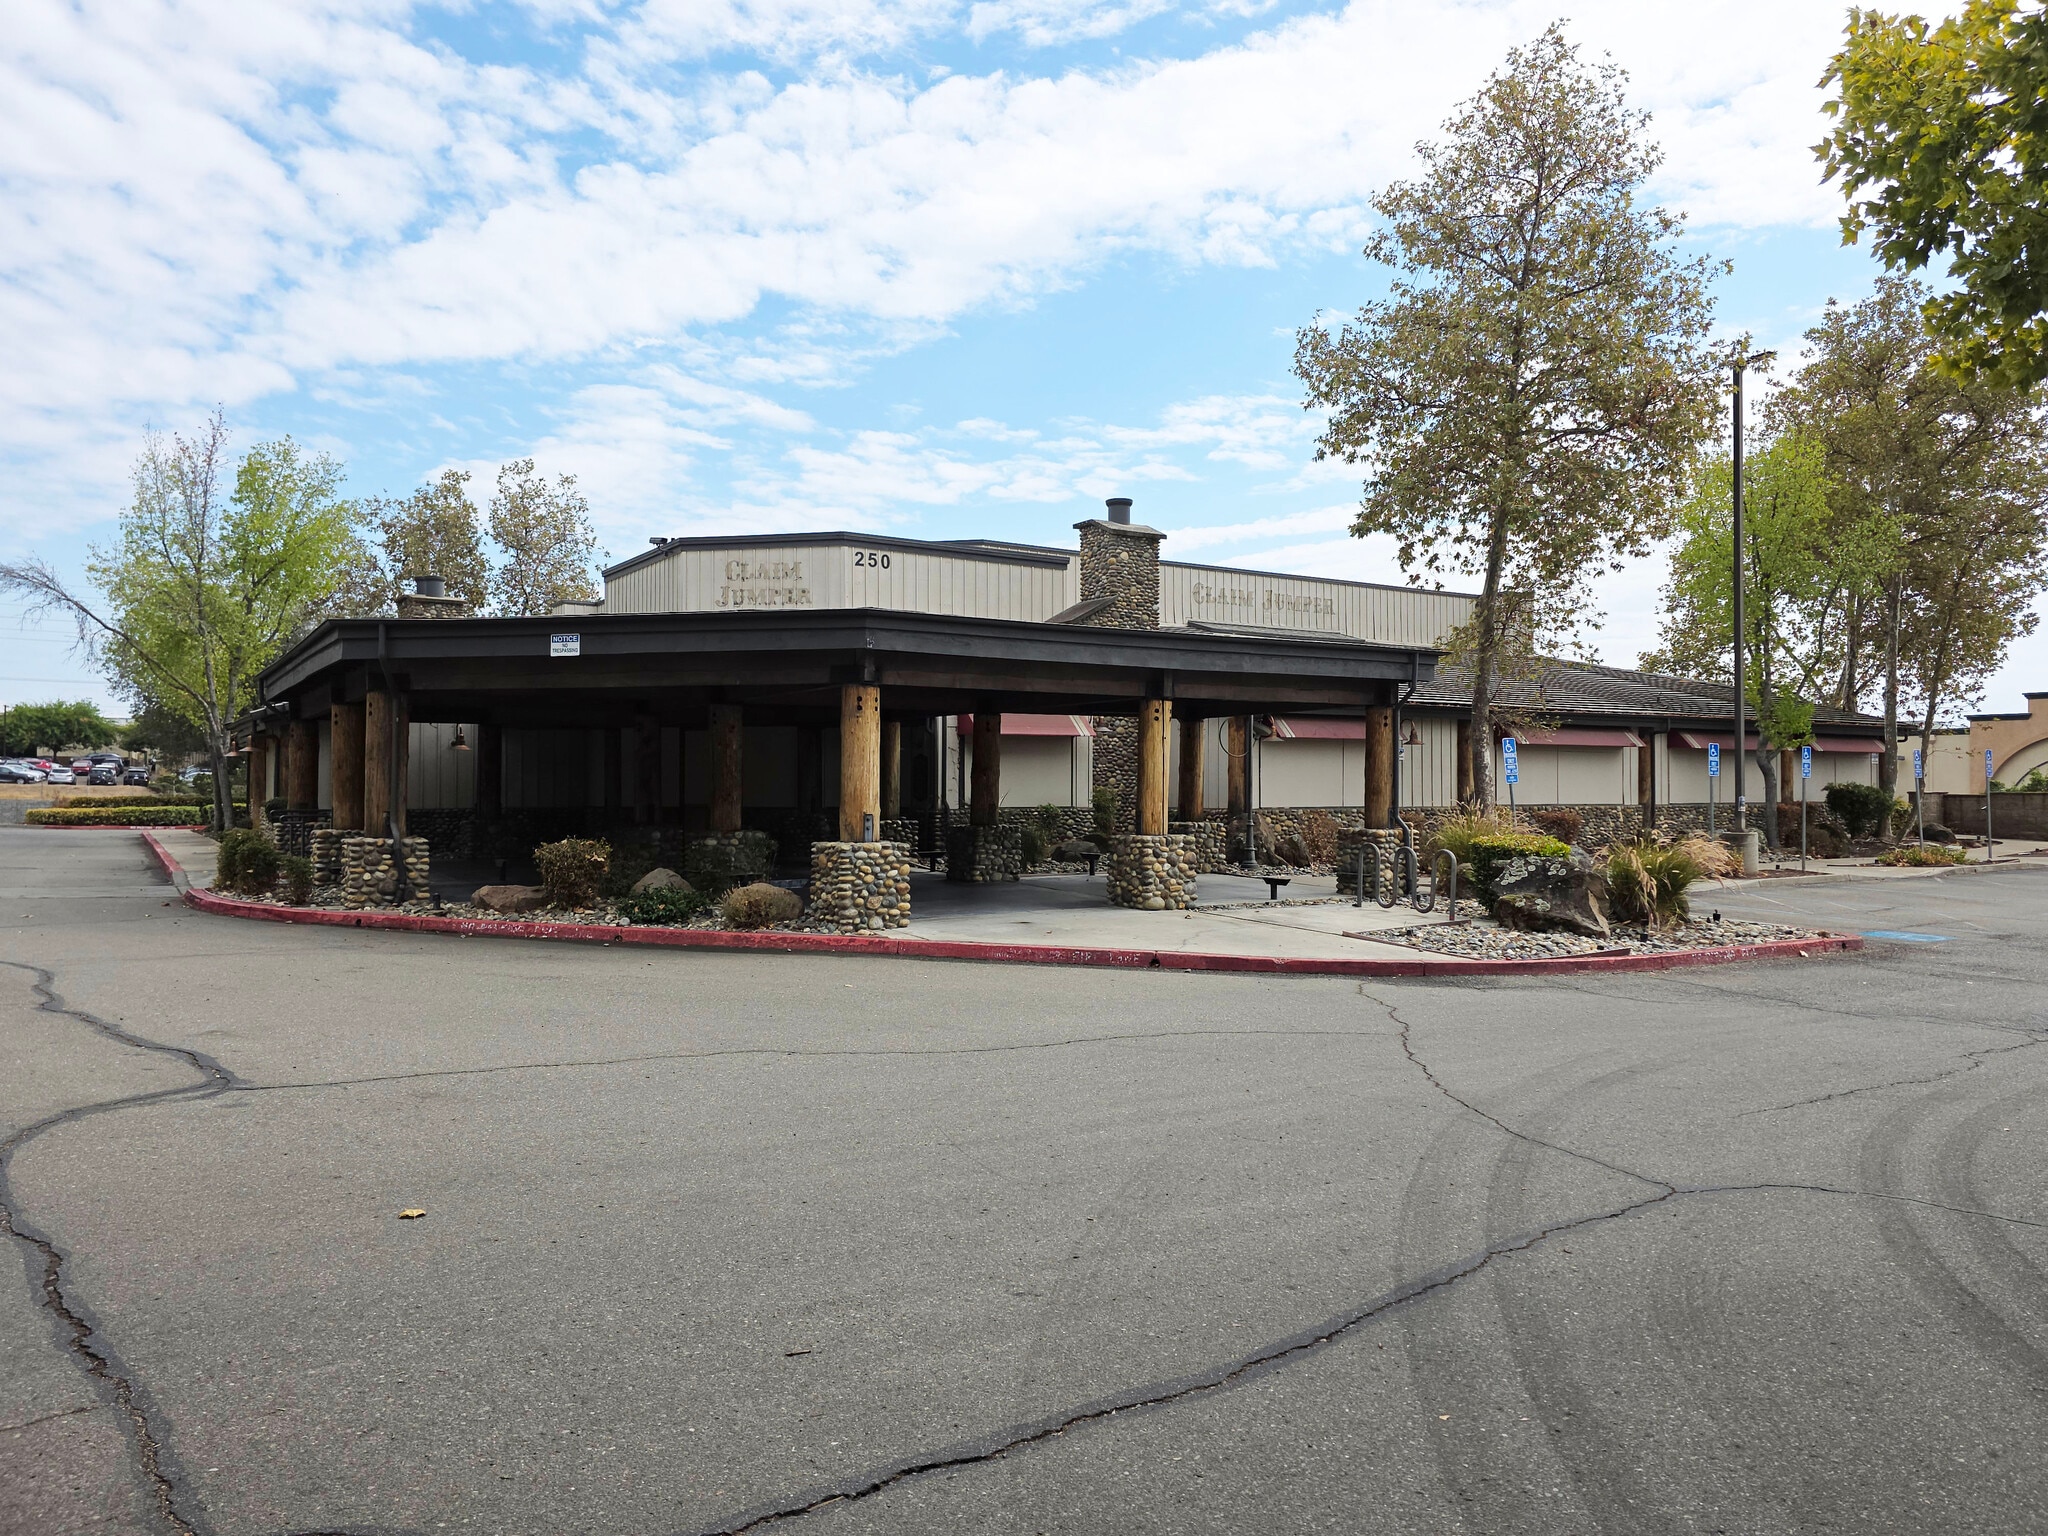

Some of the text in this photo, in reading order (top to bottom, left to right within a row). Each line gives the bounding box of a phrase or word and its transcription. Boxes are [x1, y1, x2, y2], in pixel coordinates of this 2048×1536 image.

[726, 560, 803, 582] CLAIM
[854, 551, 891, 570] 250
[715, 586, 813, 608] JUMPER
[1192, 581, 1336, 616] CLAIM JUMPER
